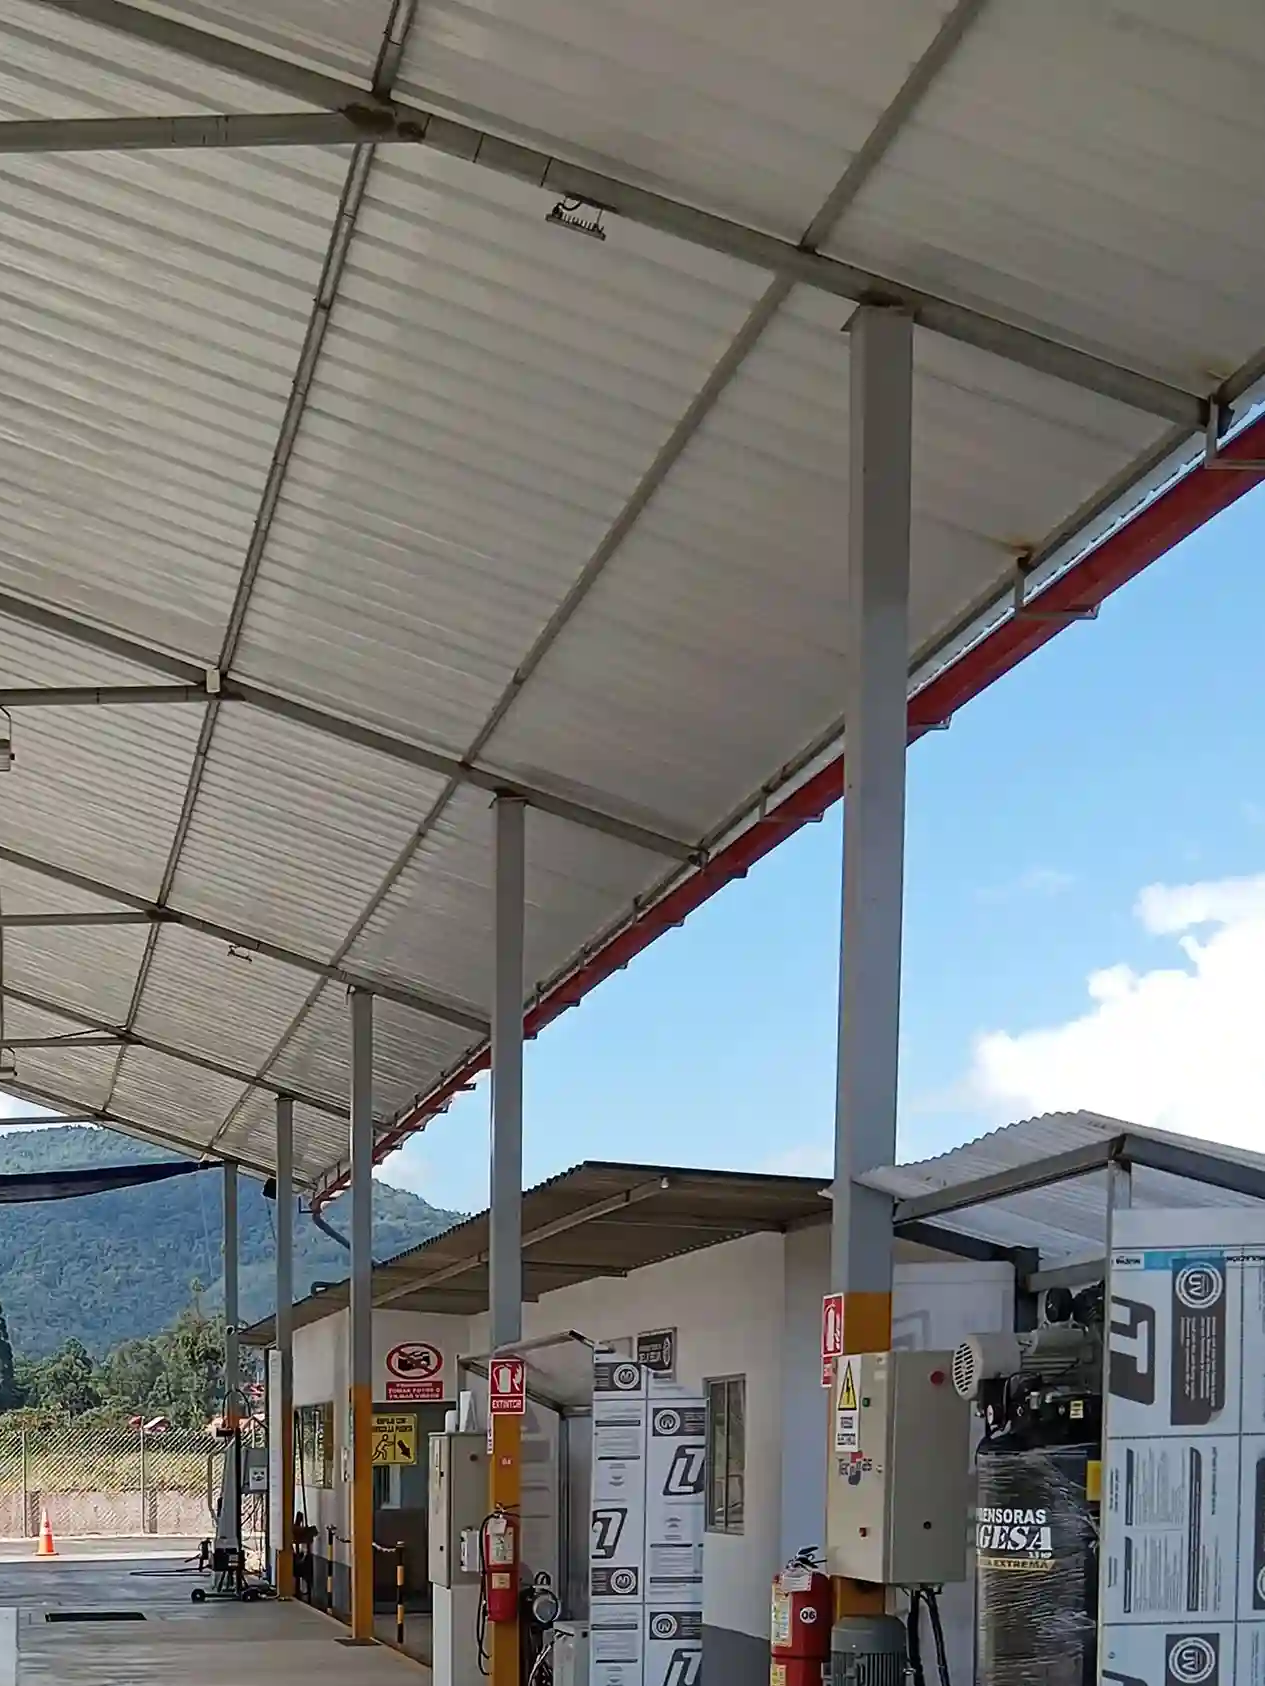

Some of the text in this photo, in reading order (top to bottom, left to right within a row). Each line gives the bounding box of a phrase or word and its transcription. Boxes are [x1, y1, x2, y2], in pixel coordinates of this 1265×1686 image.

[491, 1399, 522, 1409] EXTINTOR
[993, 1559, 1049, 1569] EXTREMA
[801, 1610, 816, 1621] 06
